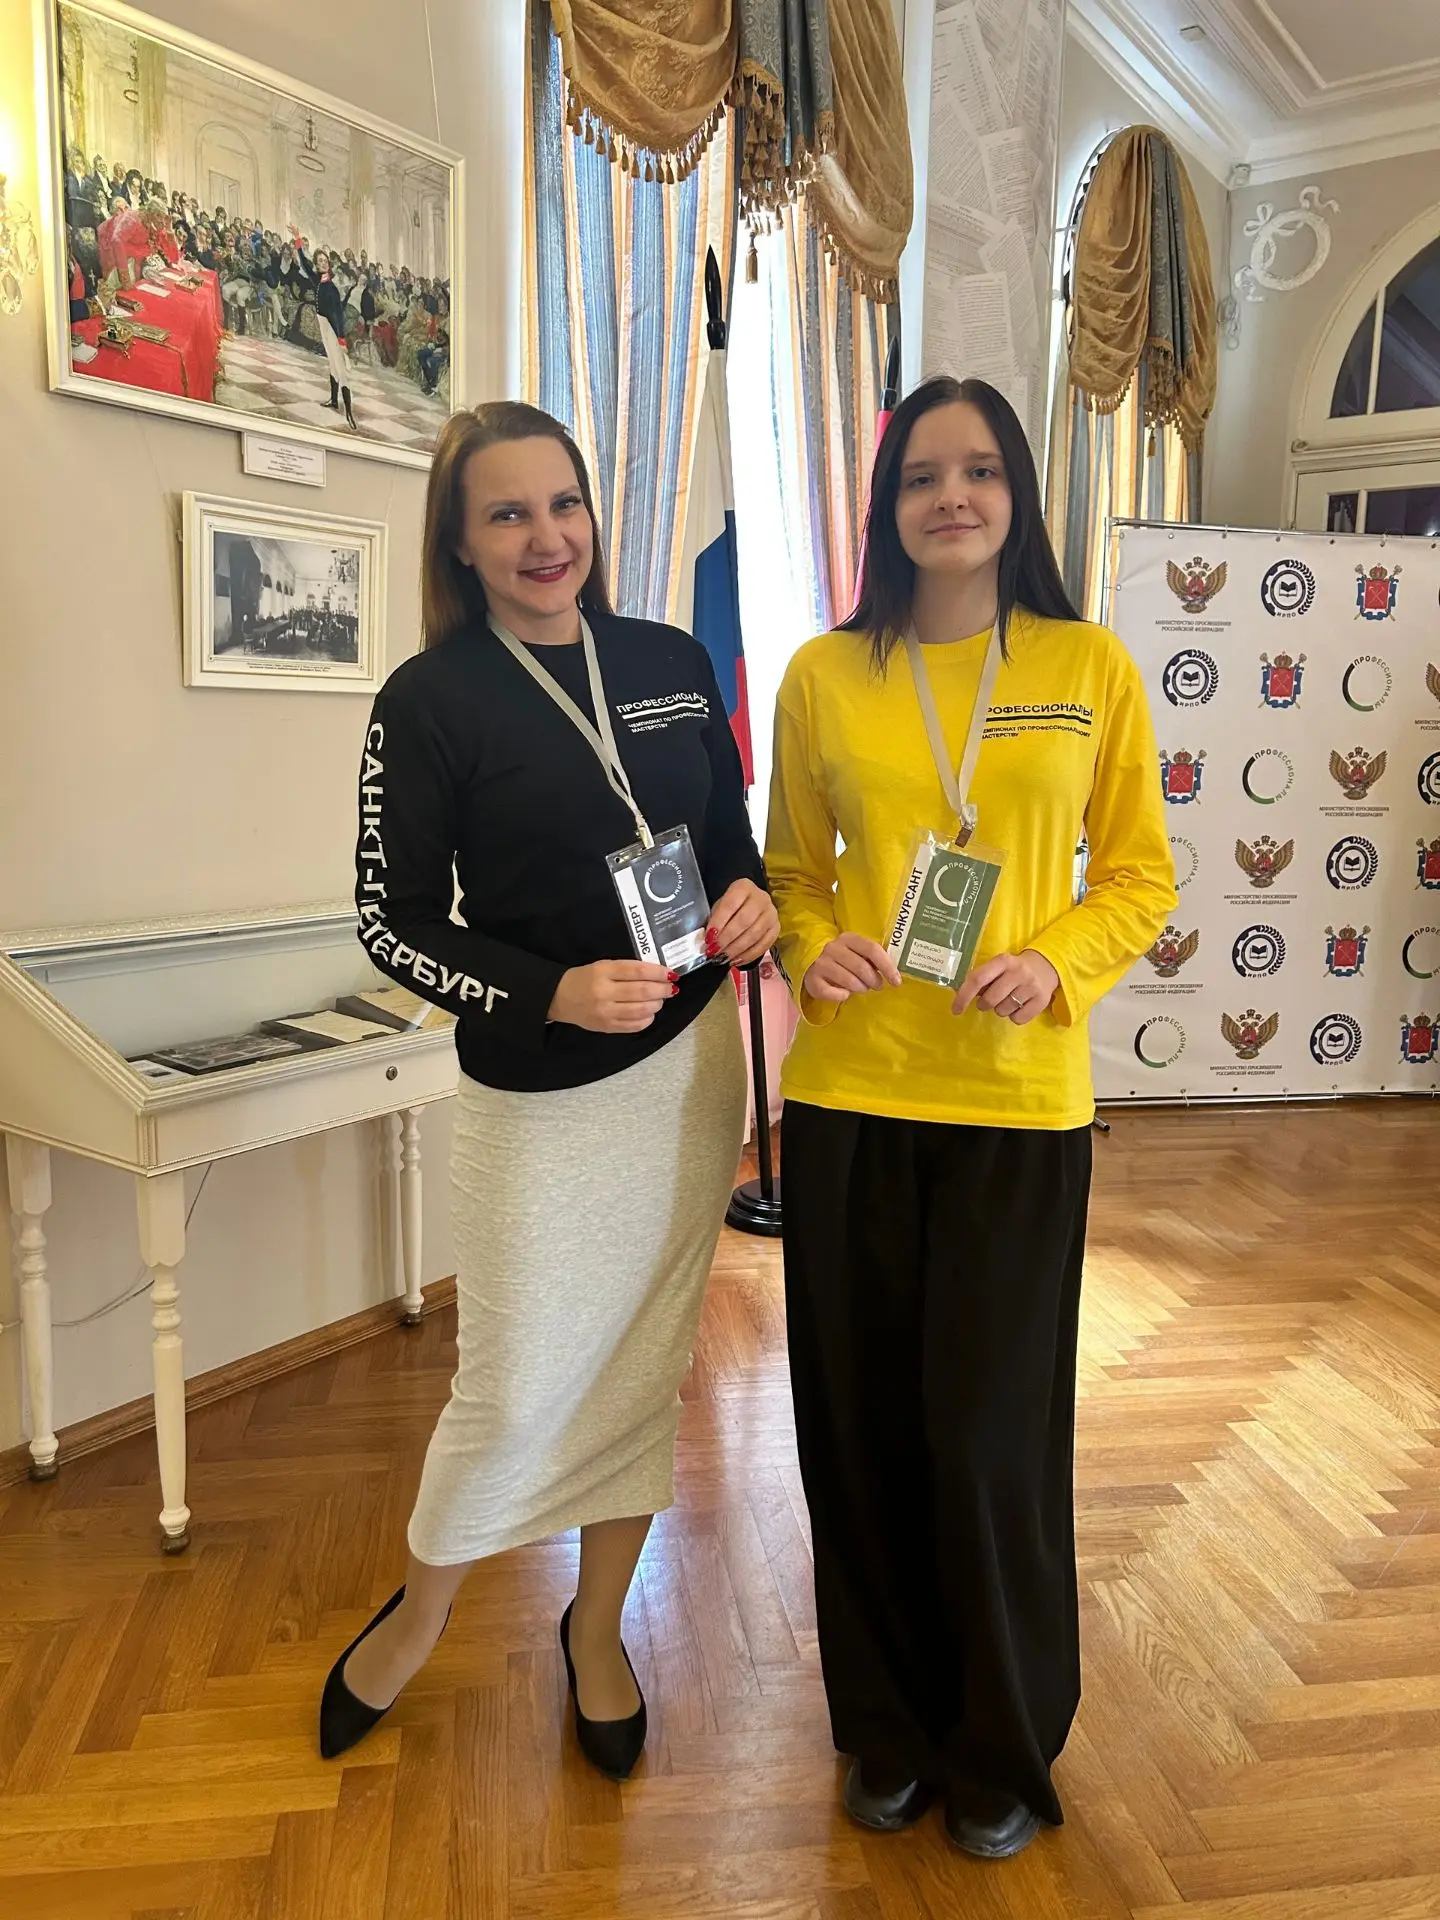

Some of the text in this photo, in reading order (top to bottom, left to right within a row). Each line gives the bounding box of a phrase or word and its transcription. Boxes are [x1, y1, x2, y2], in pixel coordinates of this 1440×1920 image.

[1353, 655, 1393, 709] ПРОФЕССИОНАЛЫ
[1254, 748, 1295, 801] ПРОФЕССИОНАЛЫ
[360, 722, 509, 1013] САНКТ-ПЕТЕРБУРГ
[1168, 836, 1199, 888] ОФЕССИОНАЛЫ
[628, 904, 651, 955] ЭКСПЕРТ
[890, 867, 923, 947] КОНКУРСАНТ
[1146, 1015, 1187, 1065] ПРОФЕССИОНАЛЫ
